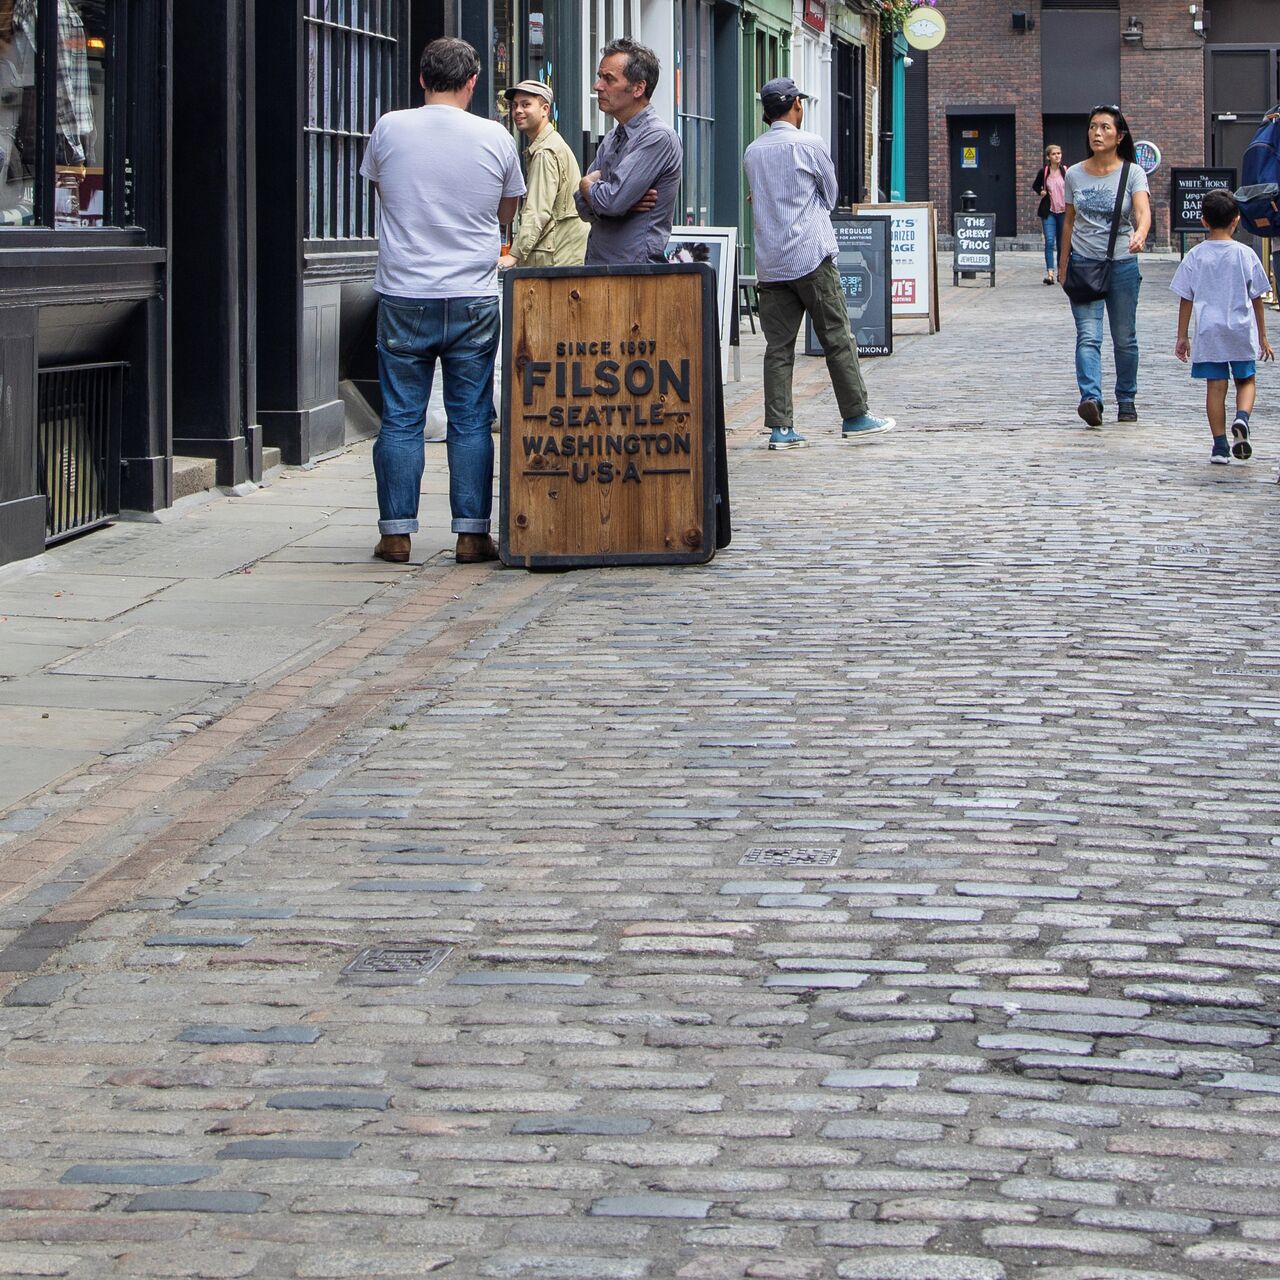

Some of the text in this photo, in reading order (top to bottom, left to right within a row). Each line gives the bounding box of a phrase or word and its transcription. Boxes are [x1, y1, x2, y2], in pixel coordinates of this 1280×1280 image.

[1179, 180, 1202, 188] WHITE
[1181, 210, 1202, 219] OPE
[964, 217, 986, 227] THE
[957, 228, 992, 239] GREAT
[959, 239, 990, 250] FROG
[960, 256, 989, 264] JEWELLERS
[556, 340, 657, 356] SINCE 1897
[856, 346, 882, 354] NIXON
[523, 358, 691, 406] FILSON
[549, 404, 665, 427] SEATTLE
[522, 432, 691, 456] WASHINGTON
